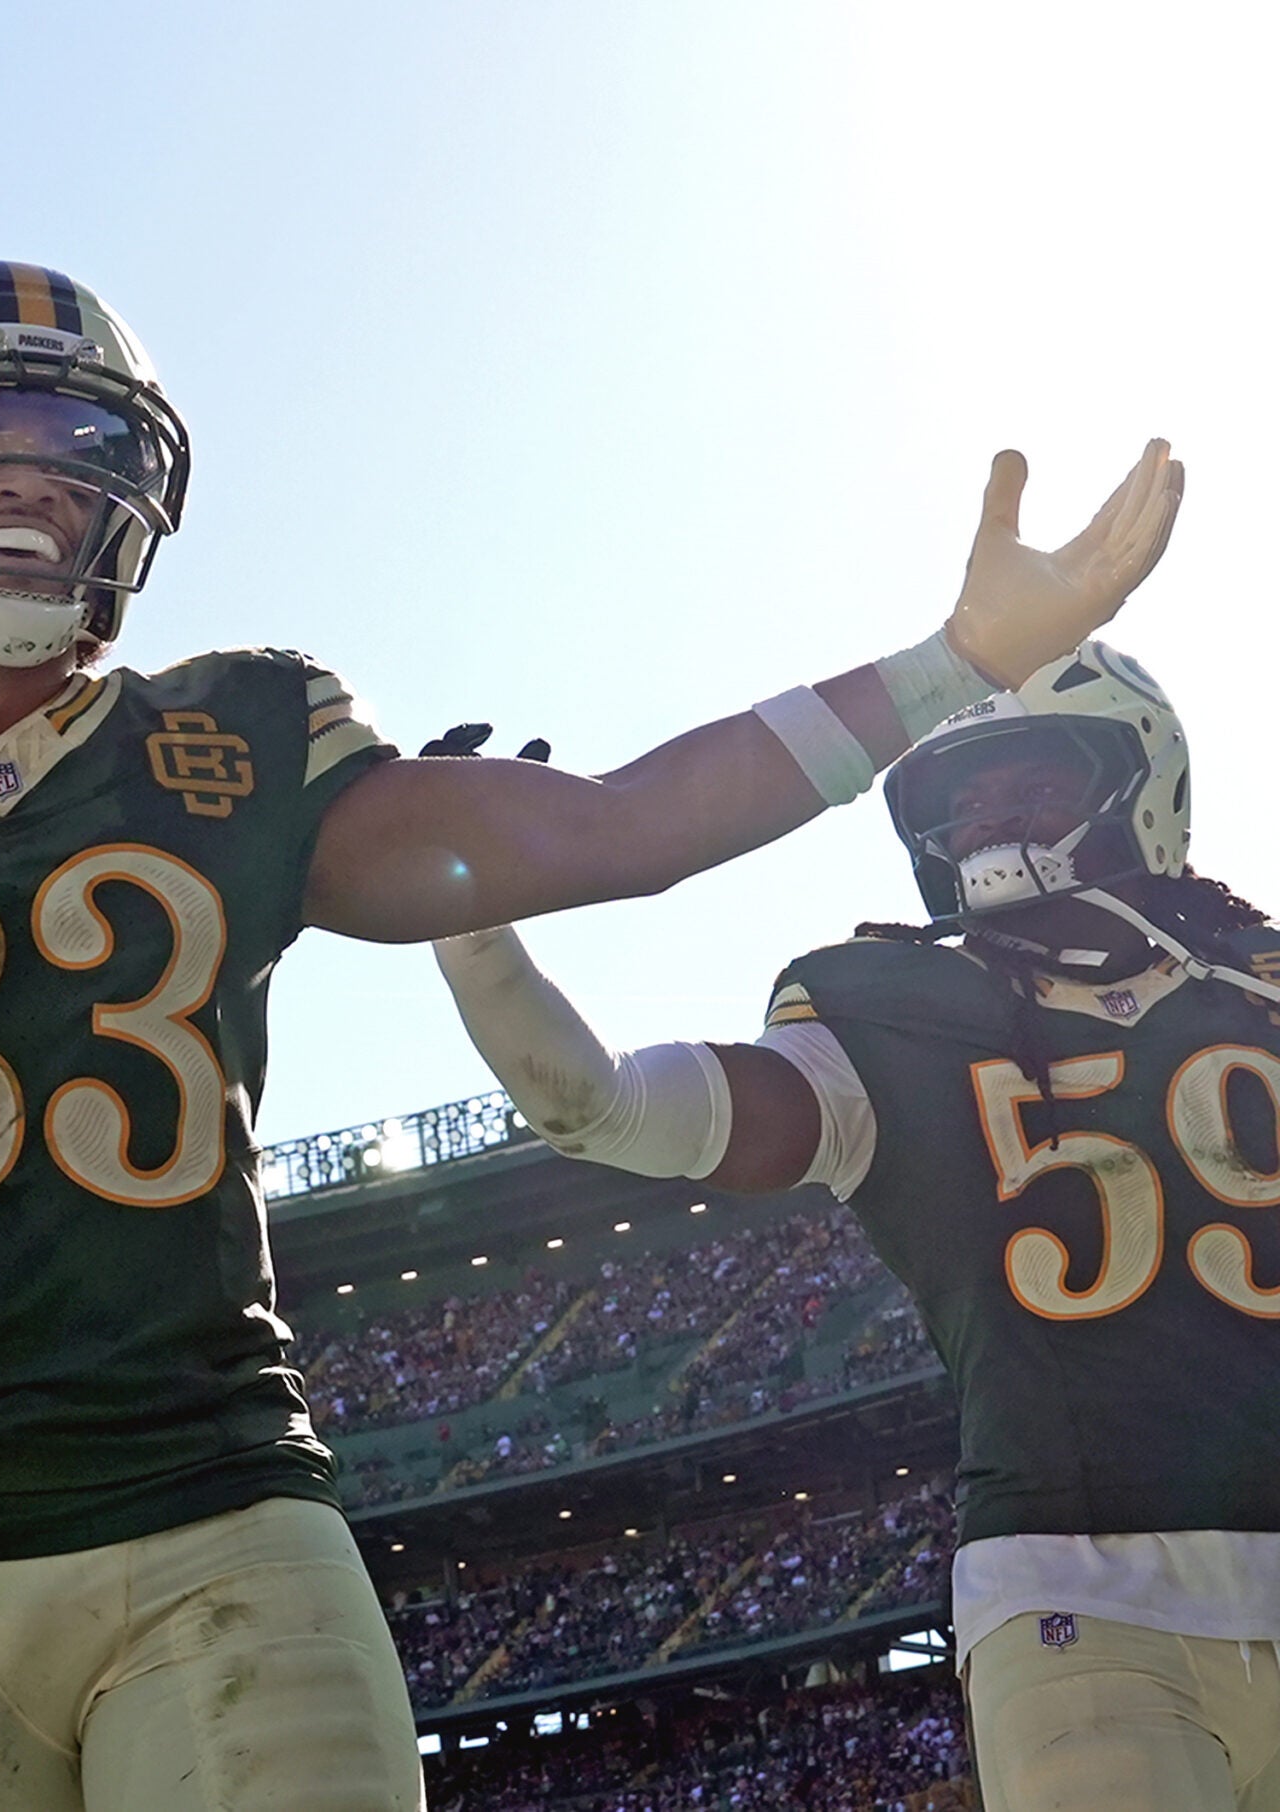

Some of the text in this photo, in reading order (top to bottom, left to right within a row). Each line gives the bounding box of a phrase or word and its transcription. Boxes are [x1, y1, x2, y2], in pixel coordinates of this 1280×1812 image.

[18, 333, 65, 353] PACKERS
[1108, 994, 1137, 1014] NFL
[970, 1043, 1280, 1320] 59
[1045, 1626, 1073, 1642] NFL
